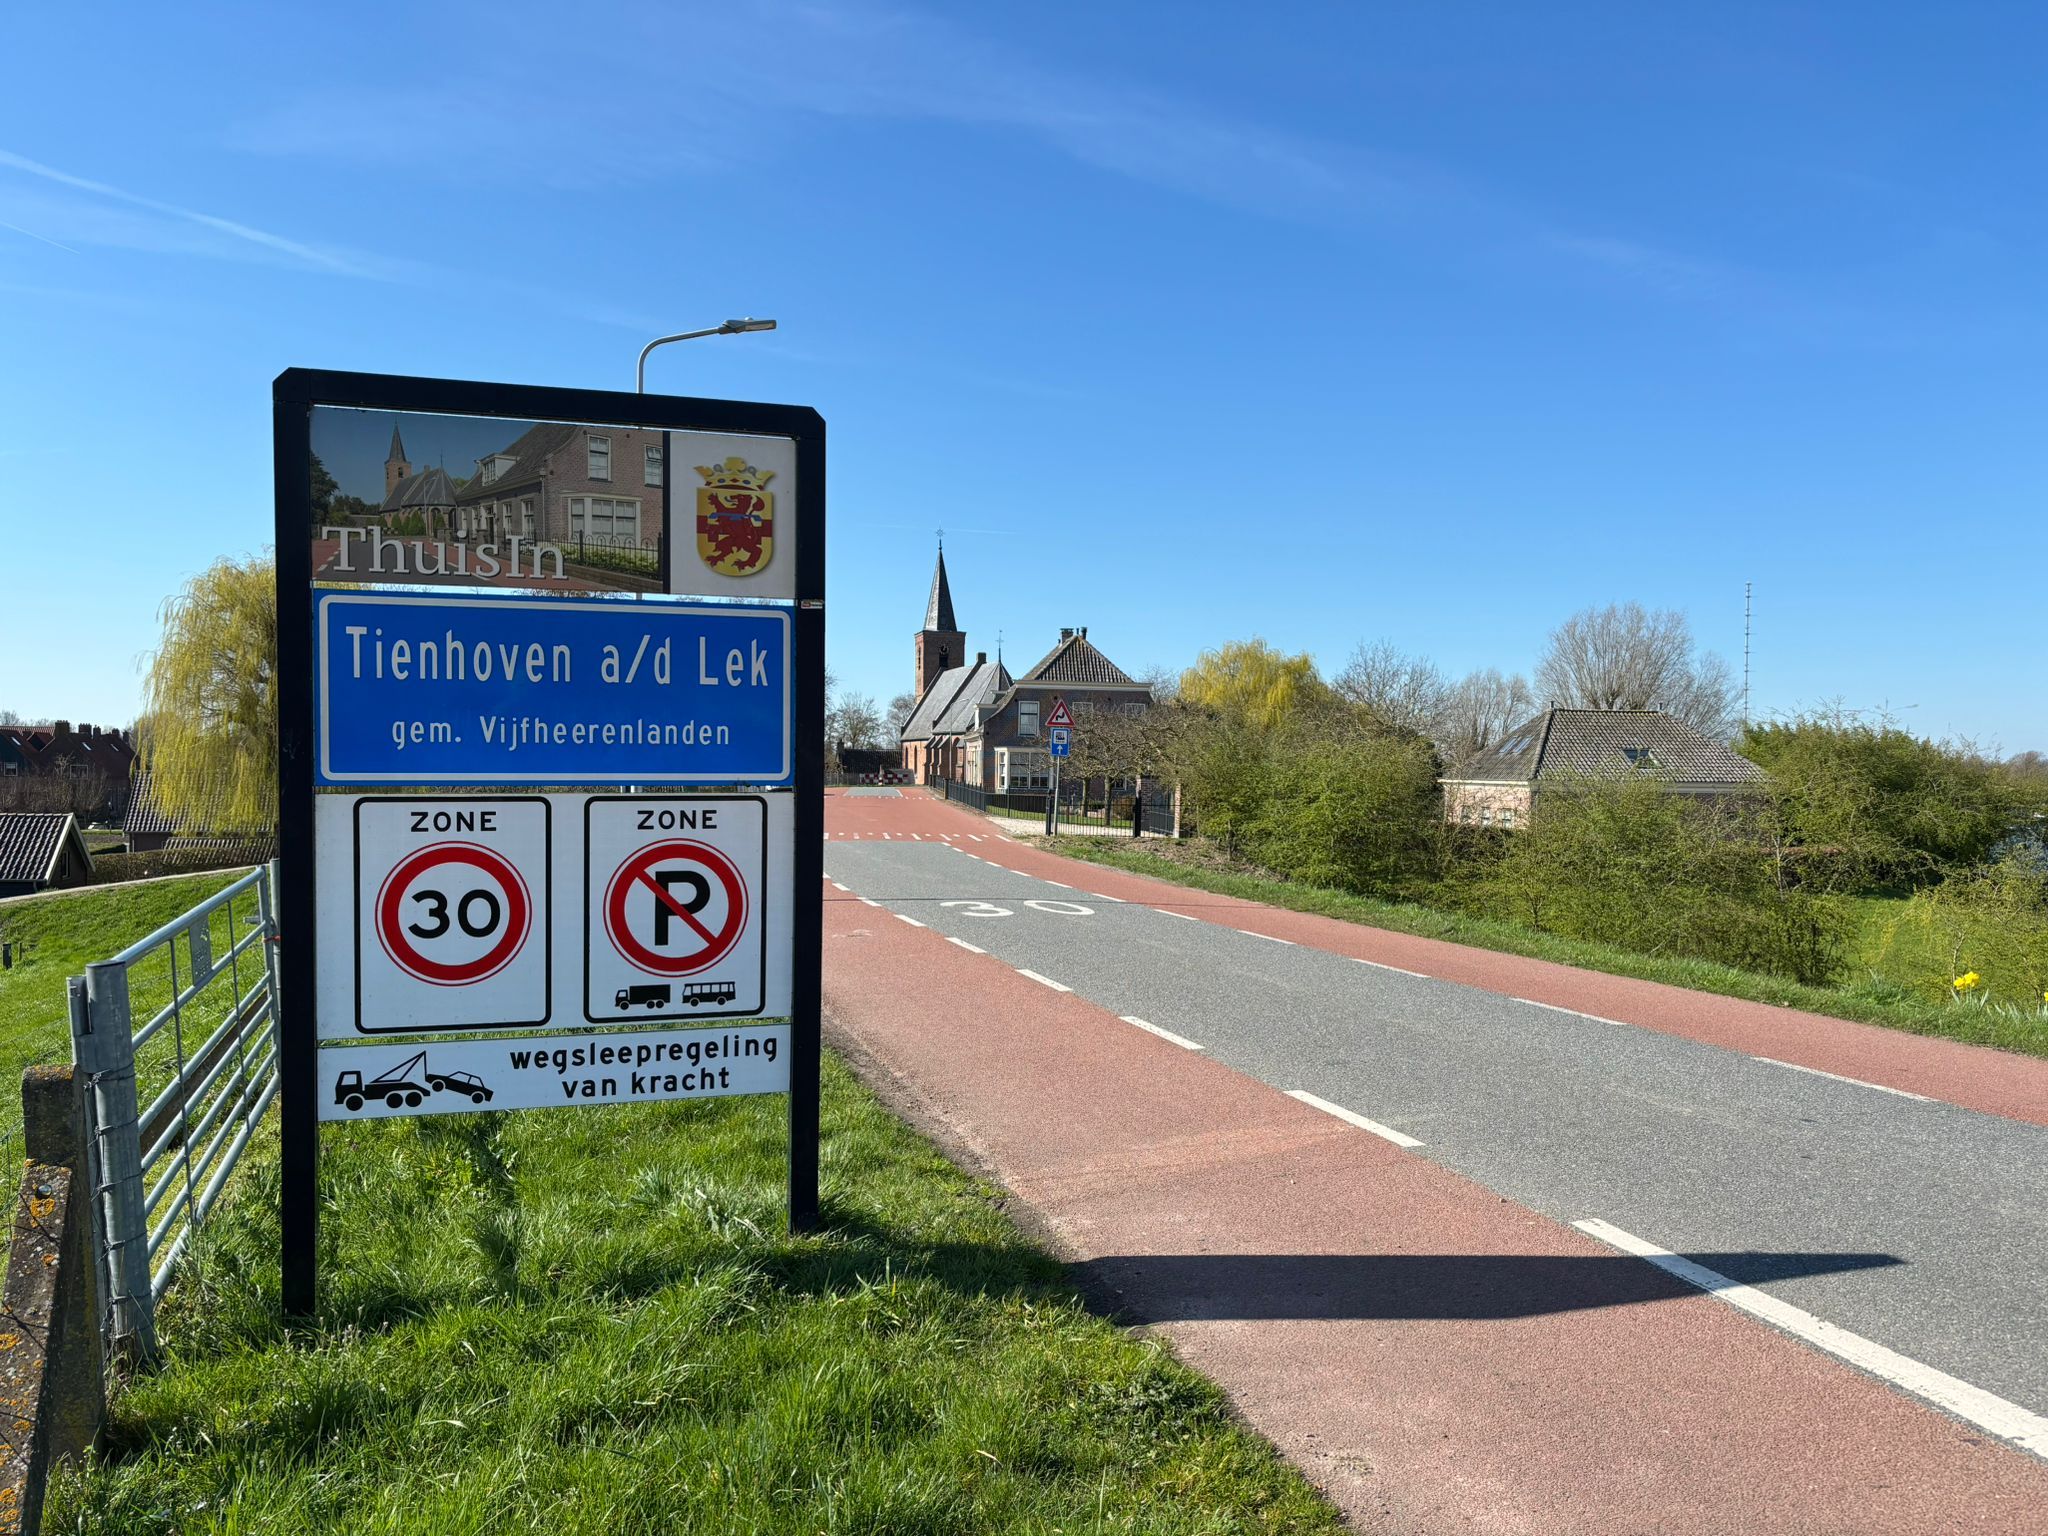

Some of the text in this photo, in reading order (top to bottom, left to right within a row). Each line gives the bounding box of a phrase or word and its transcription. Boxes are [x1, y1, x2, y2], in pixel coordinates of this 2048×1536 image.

[322, 526, 568, 580] ThuisIn
[345, 626, 768, 686] Tienhoven a/d Lek
[392, 715, 729, 751] gem. Vijfheerenlanden
[410, 811, 497, 832] ZONE
[637, 809, 717, 830] ZONE
[408, 889, 500, 939] 30
[654, 870, 711, 946] P
[939, 900, 1095, 917] 30
[510, 1035, 777, 1074] wegsleepregeling
[562, 1067, 729, 1098] van kracht
